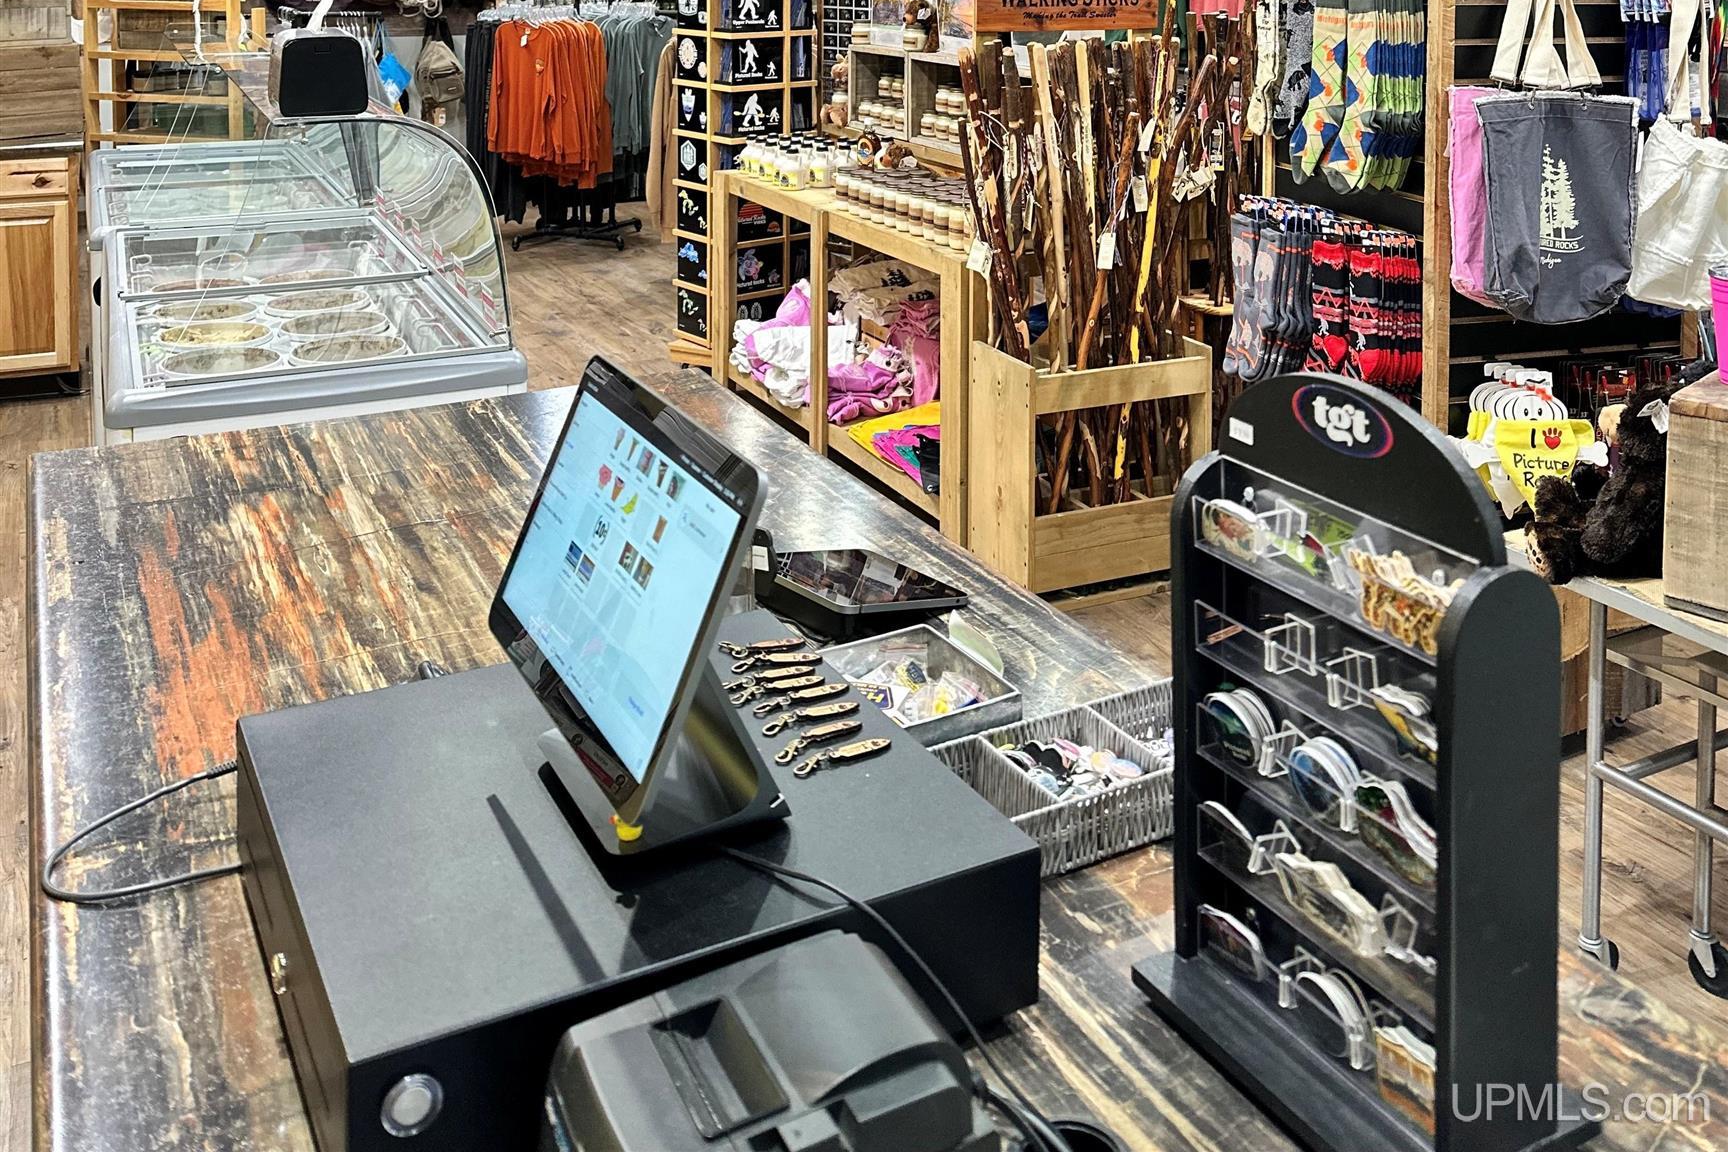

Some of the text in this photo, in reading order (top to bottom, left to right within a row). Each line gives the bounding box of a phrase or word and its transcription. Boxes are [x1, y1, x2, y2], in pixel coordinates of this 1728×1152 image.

[1555, 240, 1579, 250] ROCKS
[1312, 395, 1371, 447] tgt
[1531, 428, 1537, 448] I
